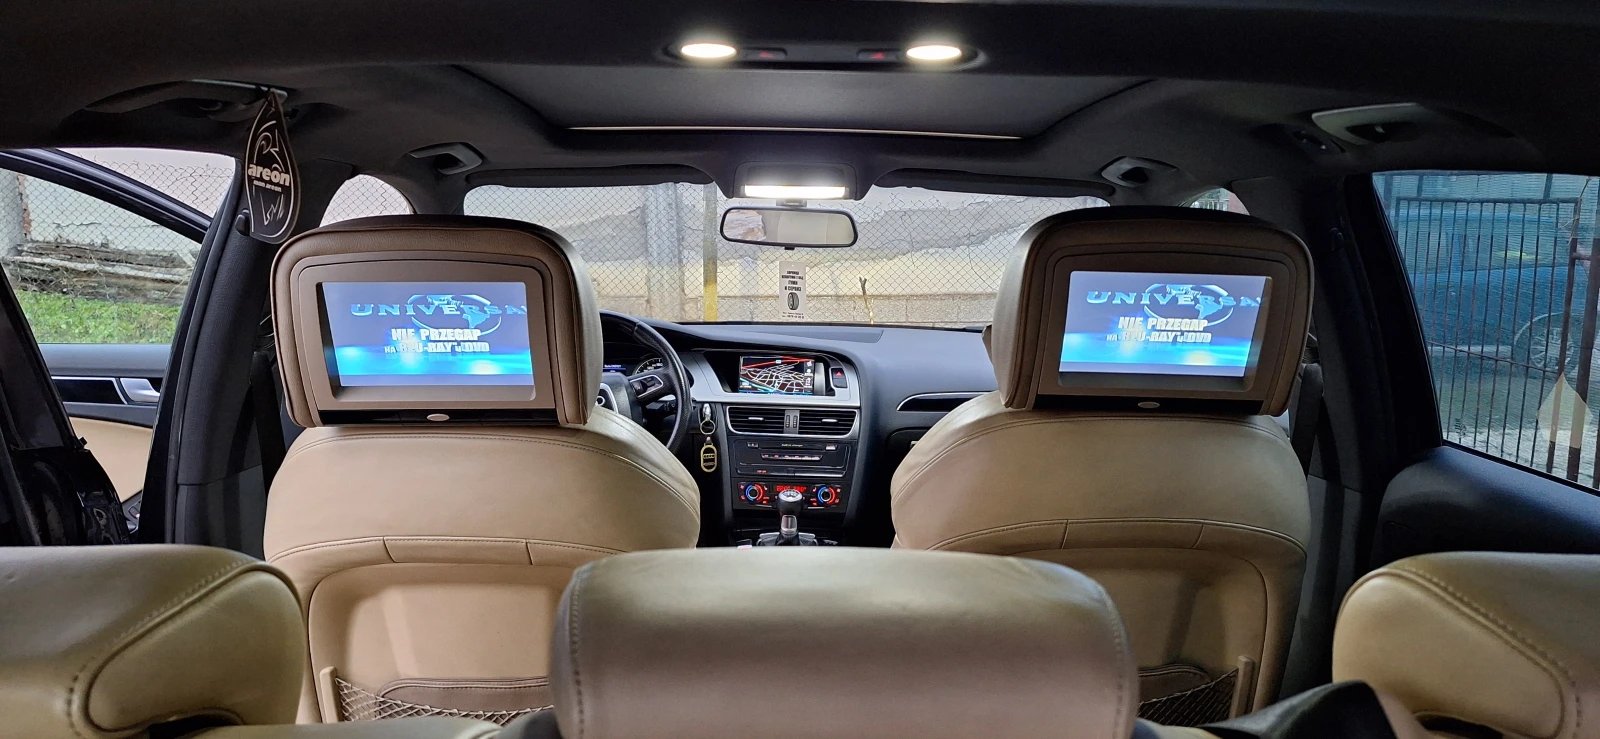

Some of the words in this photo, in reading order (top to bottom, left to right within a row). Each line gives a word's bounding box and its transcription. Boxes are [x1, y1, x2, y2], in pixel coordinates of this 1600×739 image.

[248, 164, 290, 186] areon
[1086, 291, 1262, 307] UNIVERSA
[350, 304, 527, 316] UNIVERSA
[1118, 316, 1143, 329] NIE
[1147, 317, 1208, 331] PRZEGAP
[391, 328, 415, 341] NIE
[420, 328, 481, 341] PRZEGAP
